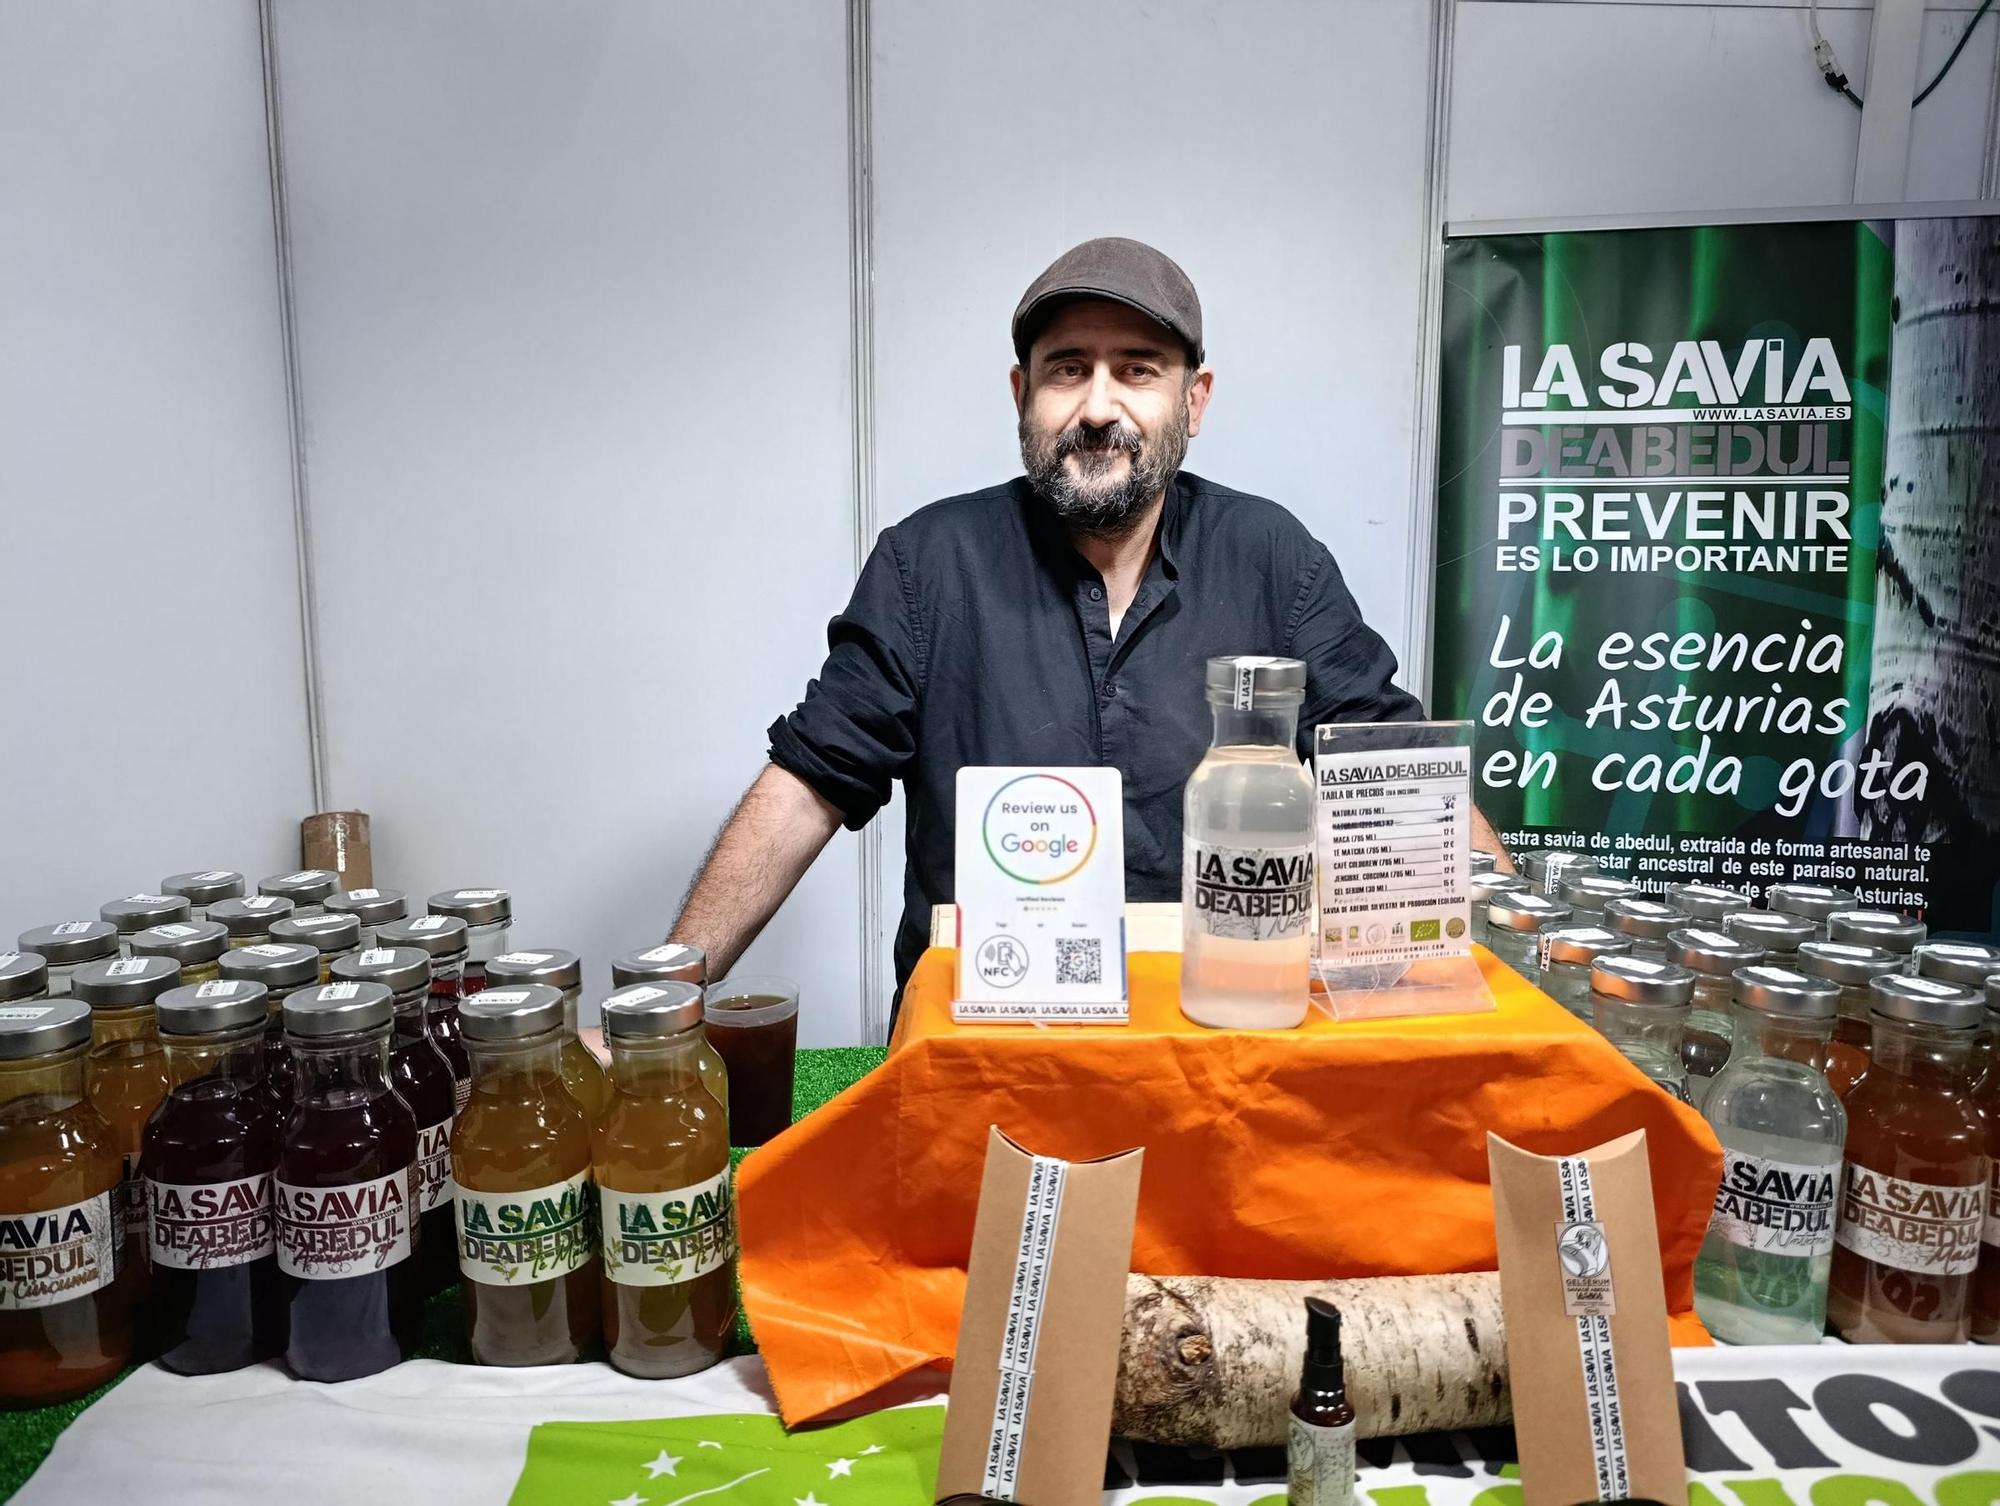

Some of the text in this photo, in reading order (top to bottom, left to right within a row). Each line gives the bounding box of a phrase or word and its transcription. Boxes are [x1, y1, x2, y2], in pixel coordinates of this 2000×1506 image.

[1502, 344, 1589, 408] LA
[1692, 407, 1847, 420] WWW.LASAVIA.ES
[1500, 424, 1850, 477] DEABEDUL
[1497, 491, 1852, 541] PREVENIR
[1496, 546, 1849, 572] ES LO IMPORTANTE
[1489, 614, 1844, 675] La esencia
[1482, 673, 1852, 735] de Asturias
[1482, 735, 1930, 818] en cada gota
[1322, 791, 1344, 801] TABLA
[1346, 790, 1354, 800] DE
[1356, 788, 1384, 798] PRECIOS
[1001, 802, 1078, 814] Review us
[1332, 809, 1357, 817] NATURAL
[1030, 820, 1050, 832] on
[1001, 833, 1078, 858] Google
[1333, 835, 1350, 843] MACA
[1500, 832, 1931, 861] estra savia de abedul, extraída de forma artesanal te
[1197, 850, 1227, 884] LA
[1638, 856, 1930, 882] ancestral de este paraíso natural.
[1740, 881, 1760, 898] de
[1853, 886, 1929, 908] Asturias,
[984, 967, 1009, 977] NFC
[1563, 1179, 1573, 1191] LA
[1580, 1178, 1590, 1191] LA
[154, 1186, 187, 1219] LA
[191, 1177, 268, 1219] SAV
[1029, 1194, 1039, 1205] LA
[1044, 1197, 1054, 1209] LA
[463, 1199, 494, 1233] LA
[619, 1203, 658, 1234] LA
[156, 1215, 271, 1249] DEABED
[1021, 1244, 1030, 1256] LA
[1036, 1247, 1046, 1260] LA
[1012, 1295, 1022, 1307] LA
[1027, 1299, 1037, 1311] LA
[1581, 1330, 1592, 1343] LA
[1599, 1330, 1610, 1343] LA
[1005, 1347, 1013, 1359] LA
[1018, 1351, 1028, 1364] LA
[1588, 1384, 1599, 1397] LA
[1606, 1384, 1617, 1397] LA
[997, 1408, 1007, 1420] LA
[1012, 1412, 1022, 1425] LA
[1595, 1437, 1606, 1450] LA
[1613, 1437, 1623, 1450] LA
[988, 1465, 998, 1478] LA
[1003, 1470, 1014, 1482] LA
